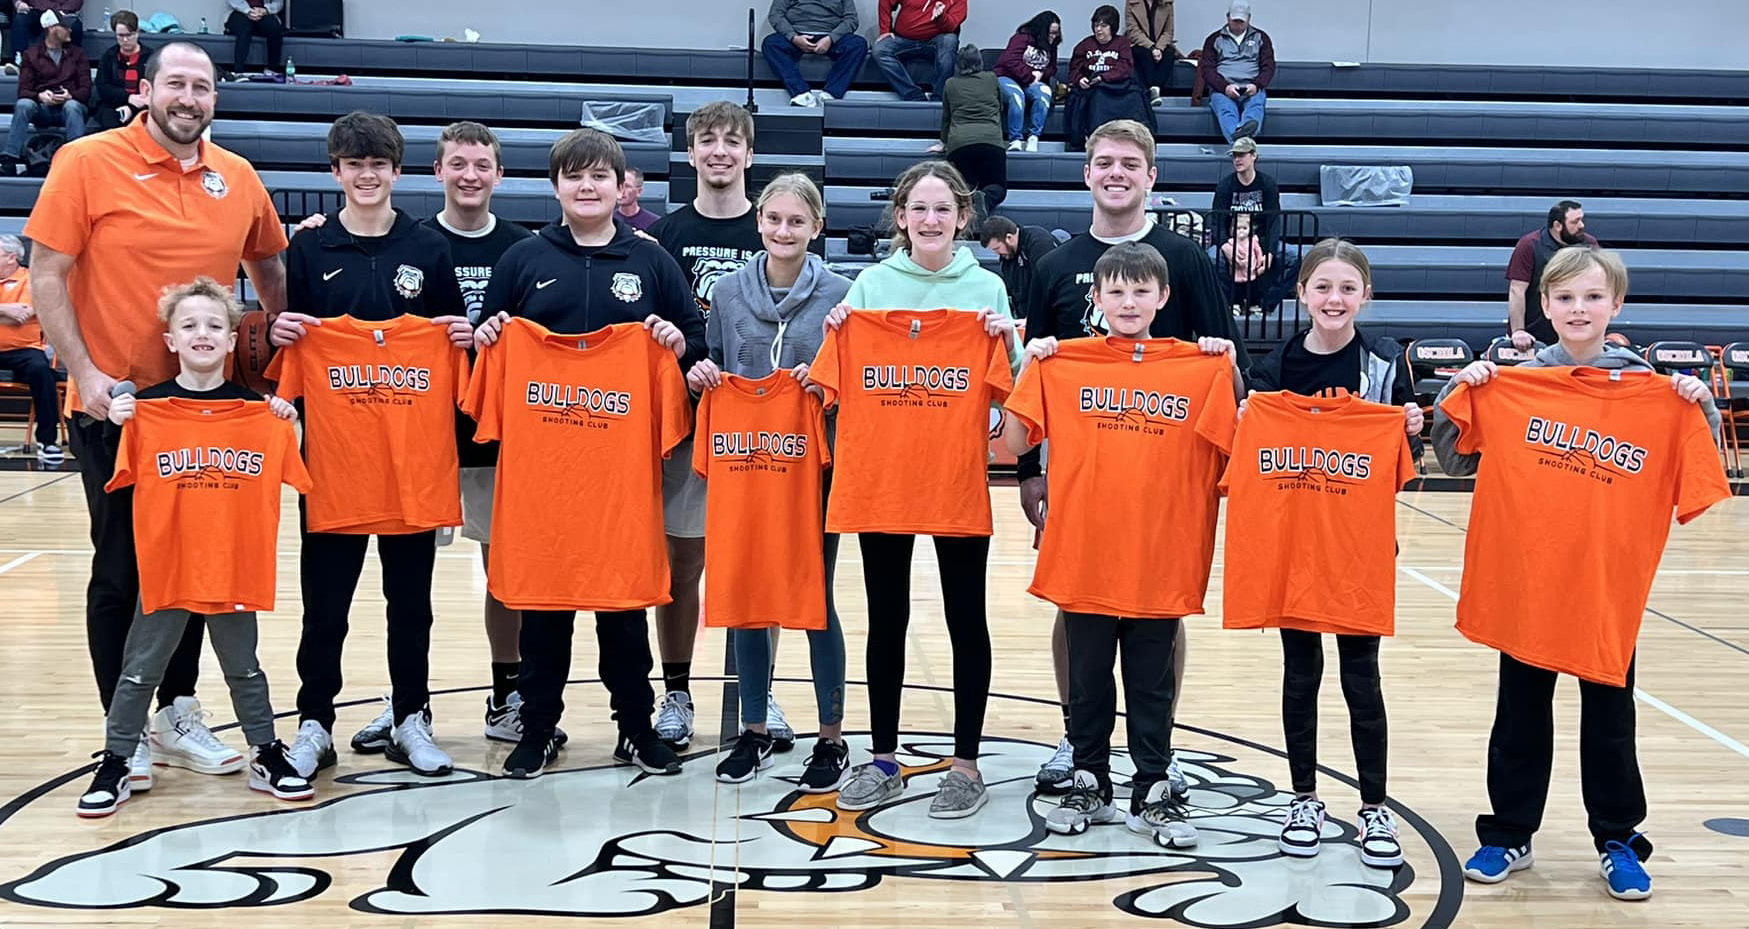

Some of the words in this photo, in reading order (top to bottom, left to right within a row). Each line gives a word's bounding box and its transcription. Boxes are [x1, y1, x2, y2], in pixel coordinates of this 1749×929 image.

[682, 246, 738, 259] PRESSURE
[741, 250, 753, 260] IS
[454, 266, 492, 277] SSURE
[327, 365, 431, 391] BULLDOGS
[863, 365, 969, 391] BULLDOGS
[526, 381, 630, 415] BULLDOGS
[1080, 387, 1190, 421] BULLDOGS
[542, 417, 584, 426] SHOOTING
[587, 421, 609, 429] CLUB
[1097, 422, 1140, 432] SHOOTING
[1143, 426, 1165, 436] CLUB
[712, 431, 807, 457] BULLDOGS
[1525, 416, 1648, 473] BULLDOGS
[156, 446, 264, 477] BULLDOGS
[728, 464, 768, 472] SHOOTING
[770, 465, 787, 473] CLUB
[1258, 446, 1372, 479] BULLDOGS
[1538, 457, 1587, 475] SHOOTING
[1590, 470, 1613, 484] CLUB
[1277, 482, 1322, 492] SHOOTING
[1324, 486, 1347, 495] CLUB
